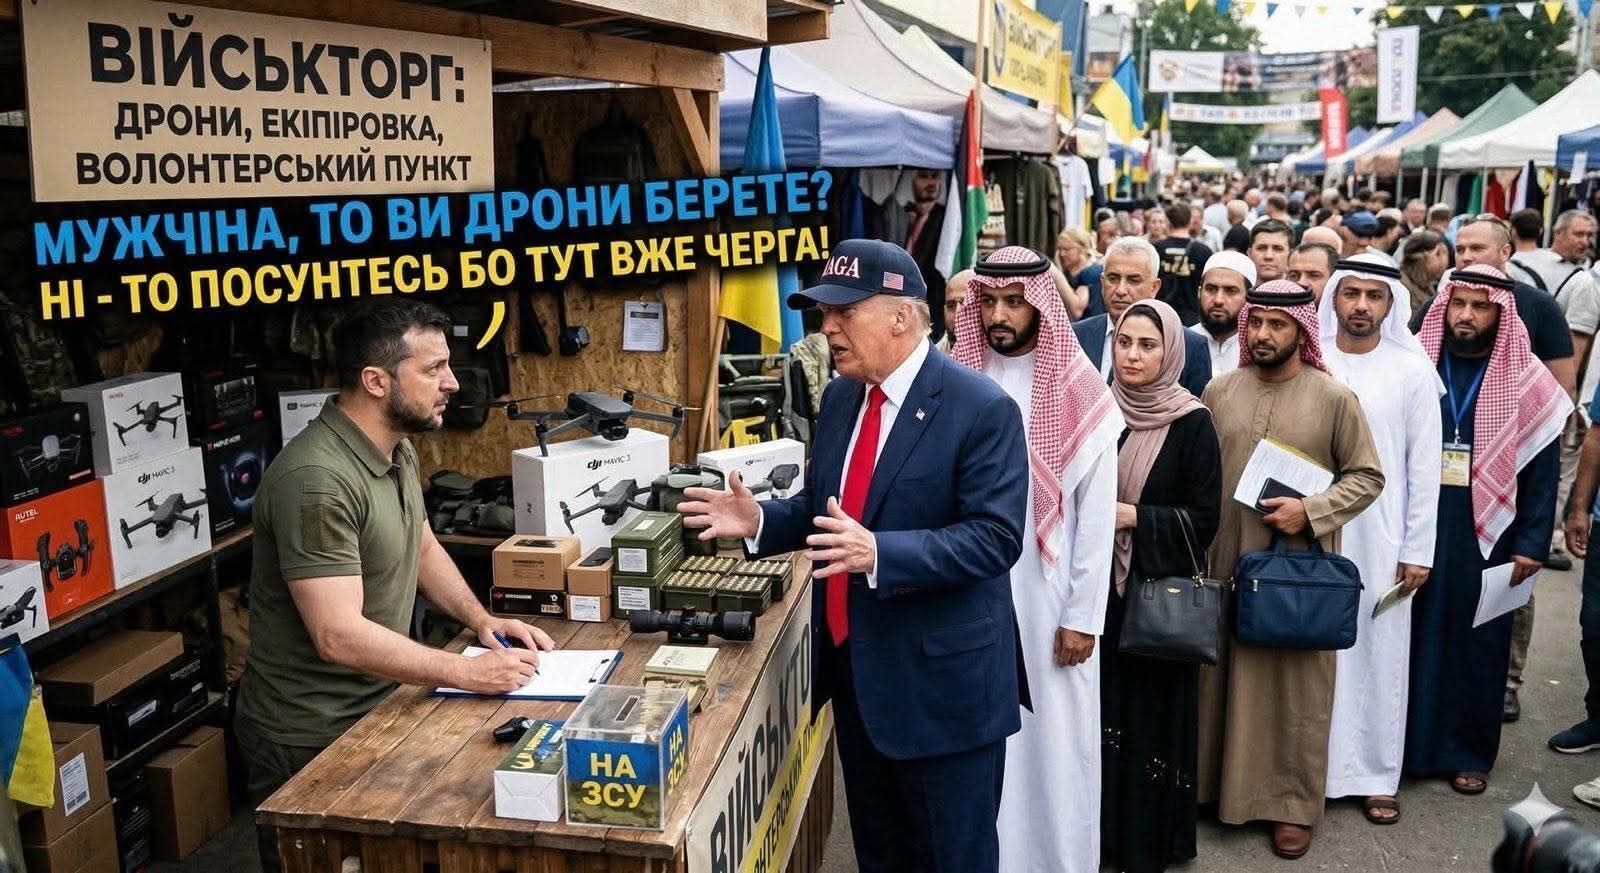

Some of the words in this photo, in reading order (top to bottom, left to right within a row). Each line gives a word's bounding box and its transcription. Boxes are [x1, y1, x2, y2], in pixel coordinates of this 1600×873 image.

[88, 13, 465, 103] ВІЙСЬКТОРГ:
[115, 102, 252, 143] ДРОНИ,
[263, 108, 444, 146] ЕКІПІРОВКА,
[76, 147, 376, 185] ВОЛОНТЕРСЬКИЙ
[385, 155, 472, 182] ПУНКТ
[15, 508, 38, 521] AUTEL
[589, 752, 637, 779] НА
[582, 780, 646, 809] ЗСУ
